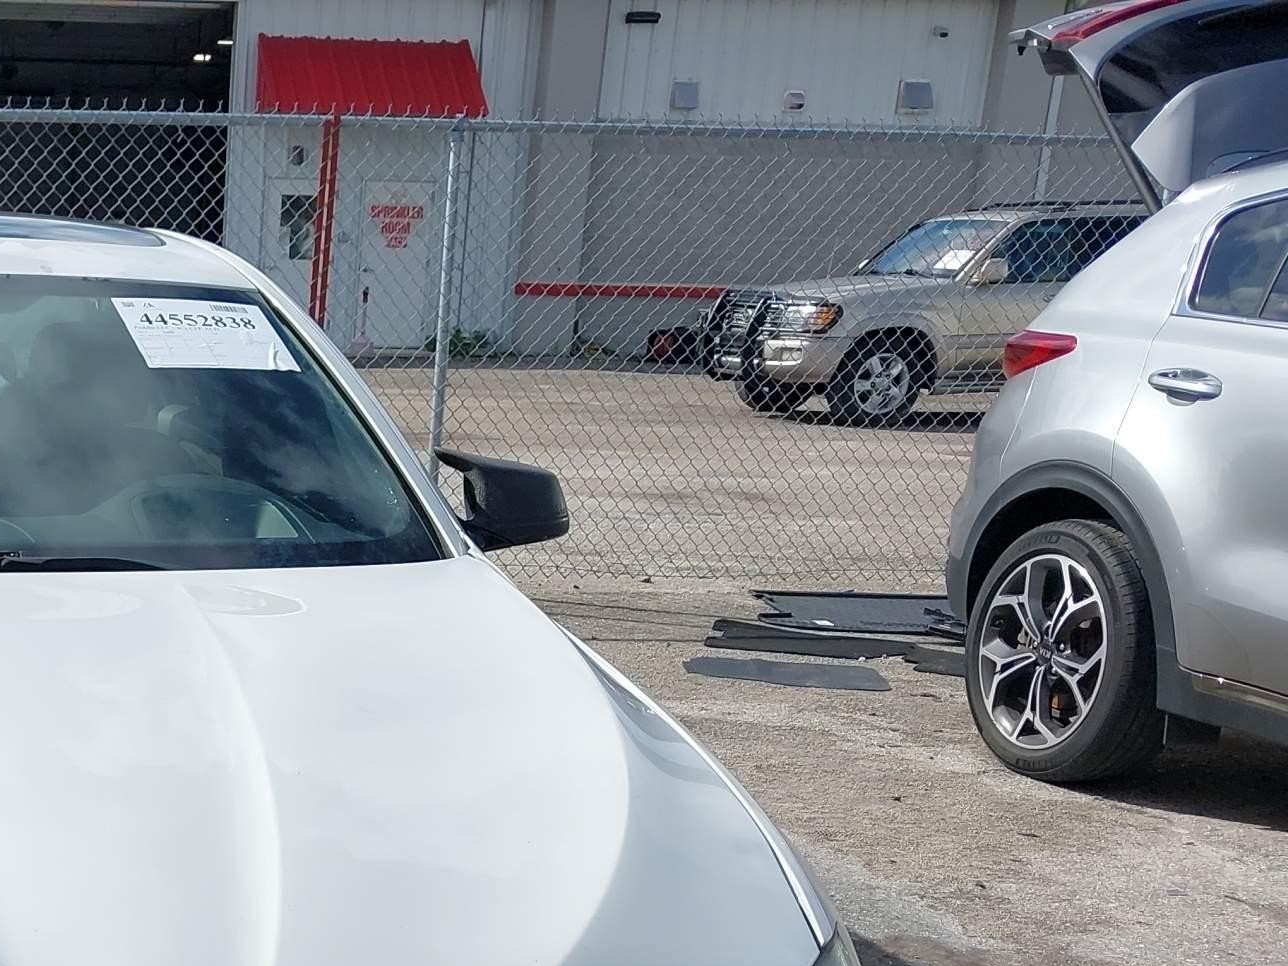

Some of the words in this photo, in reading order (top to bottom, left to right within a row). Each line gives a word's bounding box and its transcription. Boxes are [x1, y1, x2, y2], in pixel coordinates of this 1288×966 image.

[370, 205, 424, 219] SPRINKLER
[380, 222, 410, 234] ROOM
[139, 313, 256, 330] 44552838
